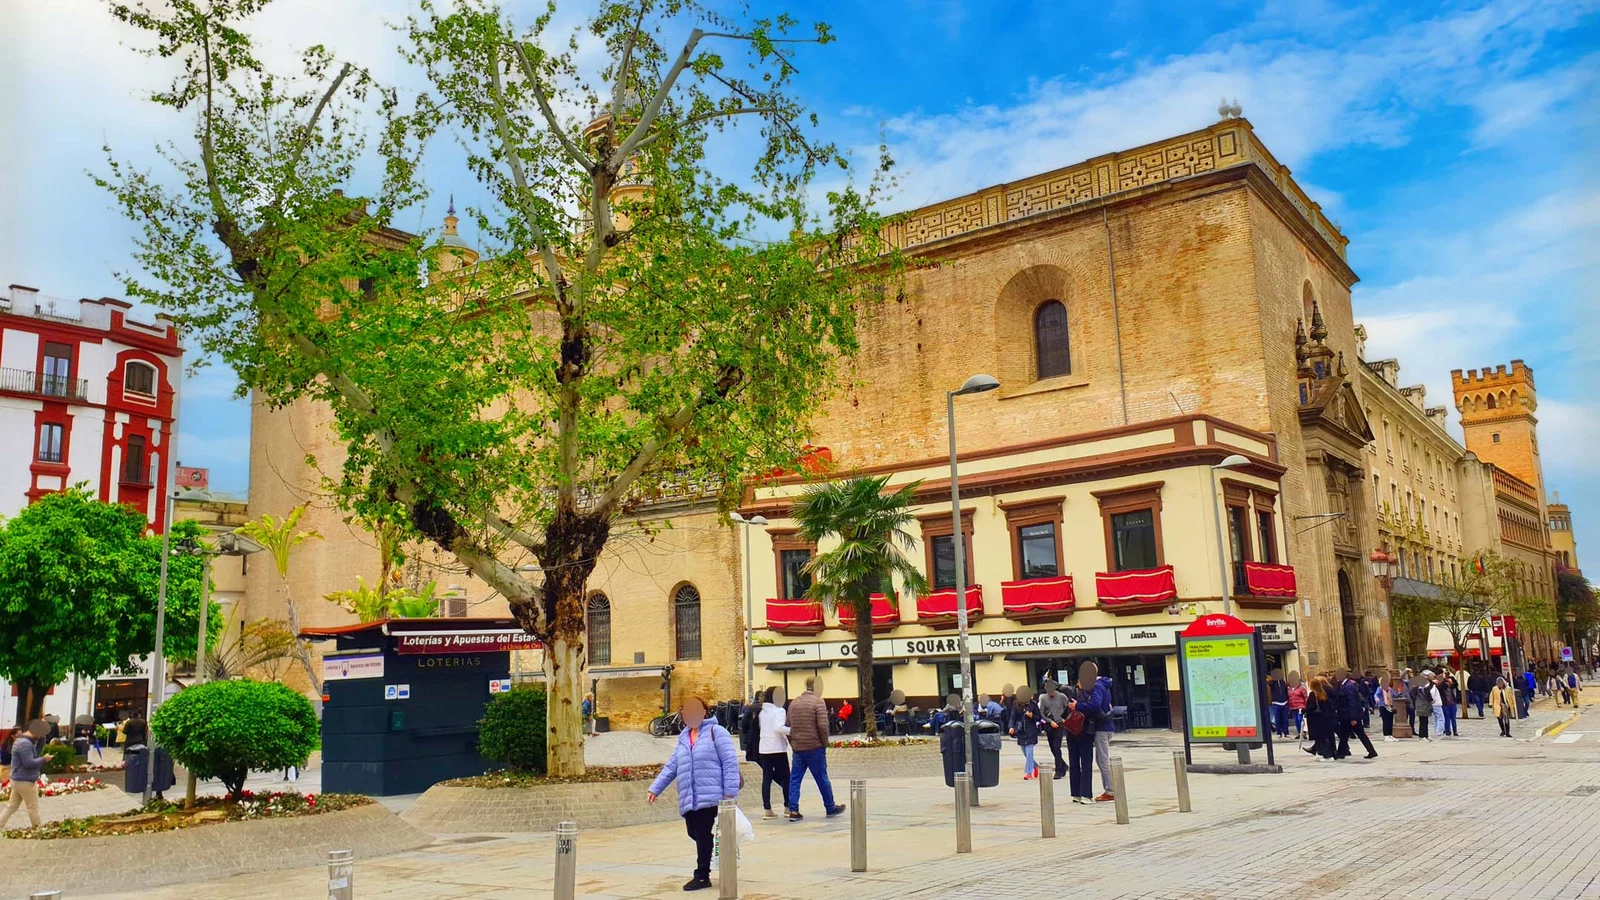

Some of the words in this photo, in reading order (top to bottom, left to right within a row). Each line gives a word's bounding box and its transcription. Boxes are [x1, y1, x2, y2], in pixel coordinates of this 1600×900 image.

[403, 635, 442, 646] Loterías
[444, 635, 452, 647] y
[453, 634, 494, 646] Apuestas
[497, 634, 510, 643] del
[1026, 636, 1050, 645] CAKE
[1052, 635, 1060, 645] &
[1062, 634, 1087, 644] FOOD
[1130, 630, 1157, 640] LAVAZZA
[906, 639, 961, 653] SQUAR
[418, 657, 481, 667] LOTERIAS
